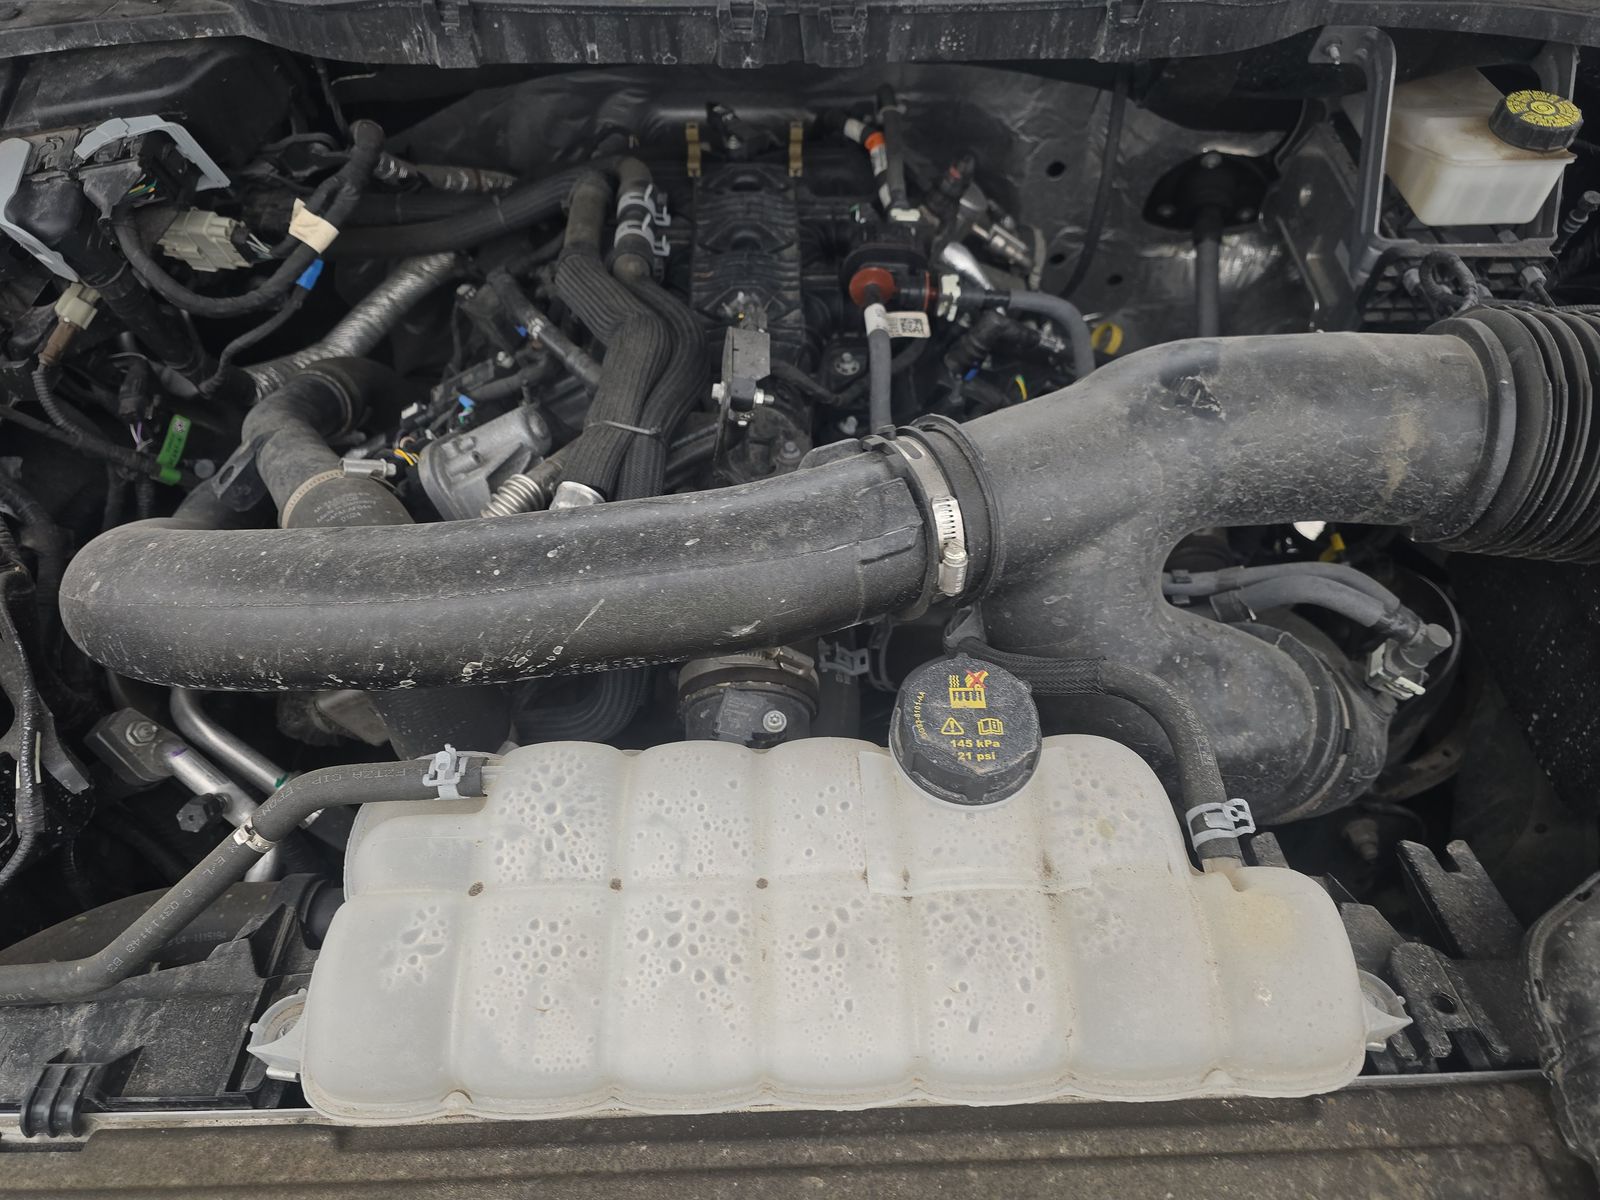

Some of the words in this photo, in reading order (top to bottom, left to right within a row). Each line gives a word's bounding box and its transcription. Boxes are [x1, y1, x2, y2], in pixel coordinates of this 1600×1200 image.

[950, 739, 973, 748] 145
[976, 739, 1001, 748] kPa
[957, 751, 973, 761] 21
[976, 751, 996, 762] psi
